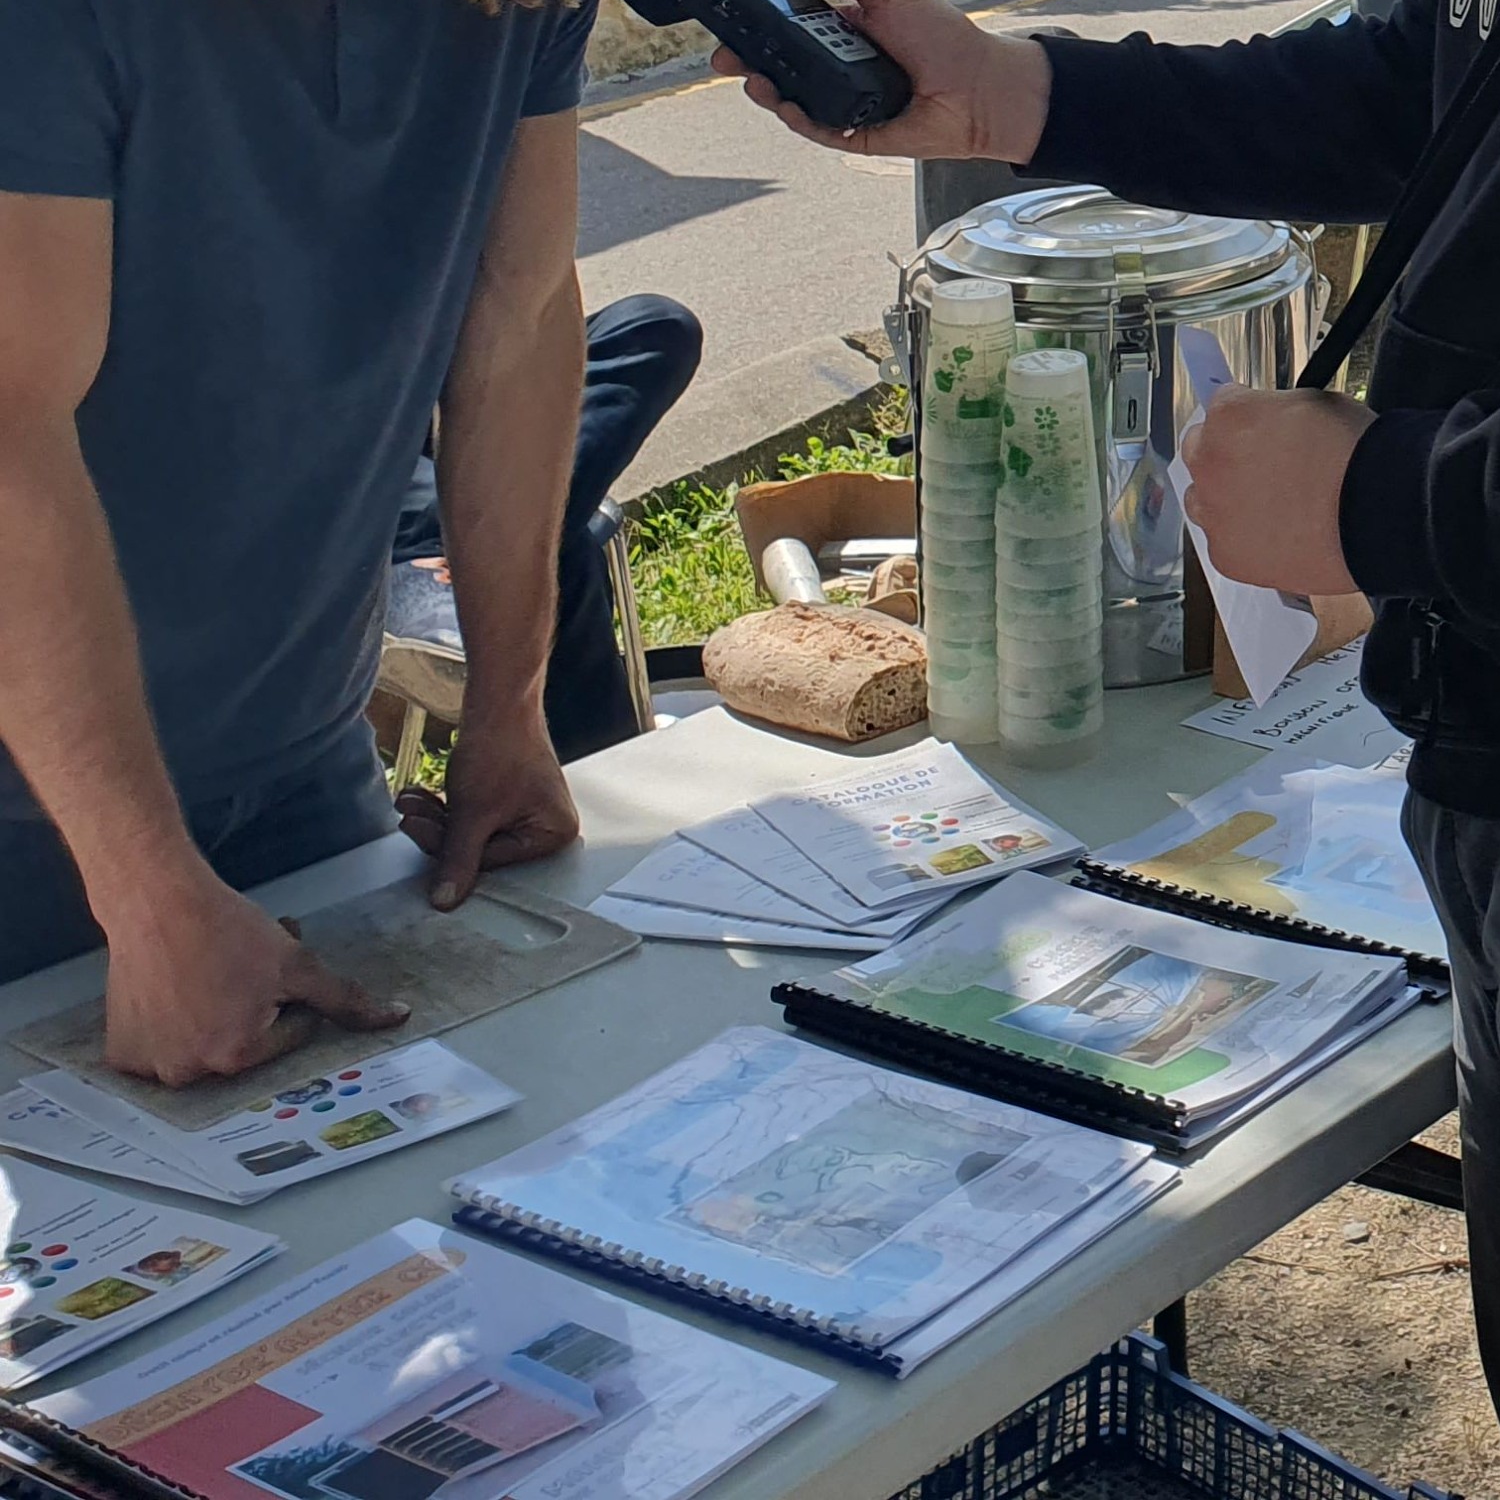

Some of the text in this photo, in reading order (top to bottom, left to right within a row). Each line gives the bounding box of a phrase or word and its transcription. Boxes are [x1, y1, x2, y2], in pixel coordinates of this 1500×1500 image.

[791, 775, 911, 807] CATALOGUE
[914, 766, 940, 778] DE
[815, 779, 933, 810] FORMATION
